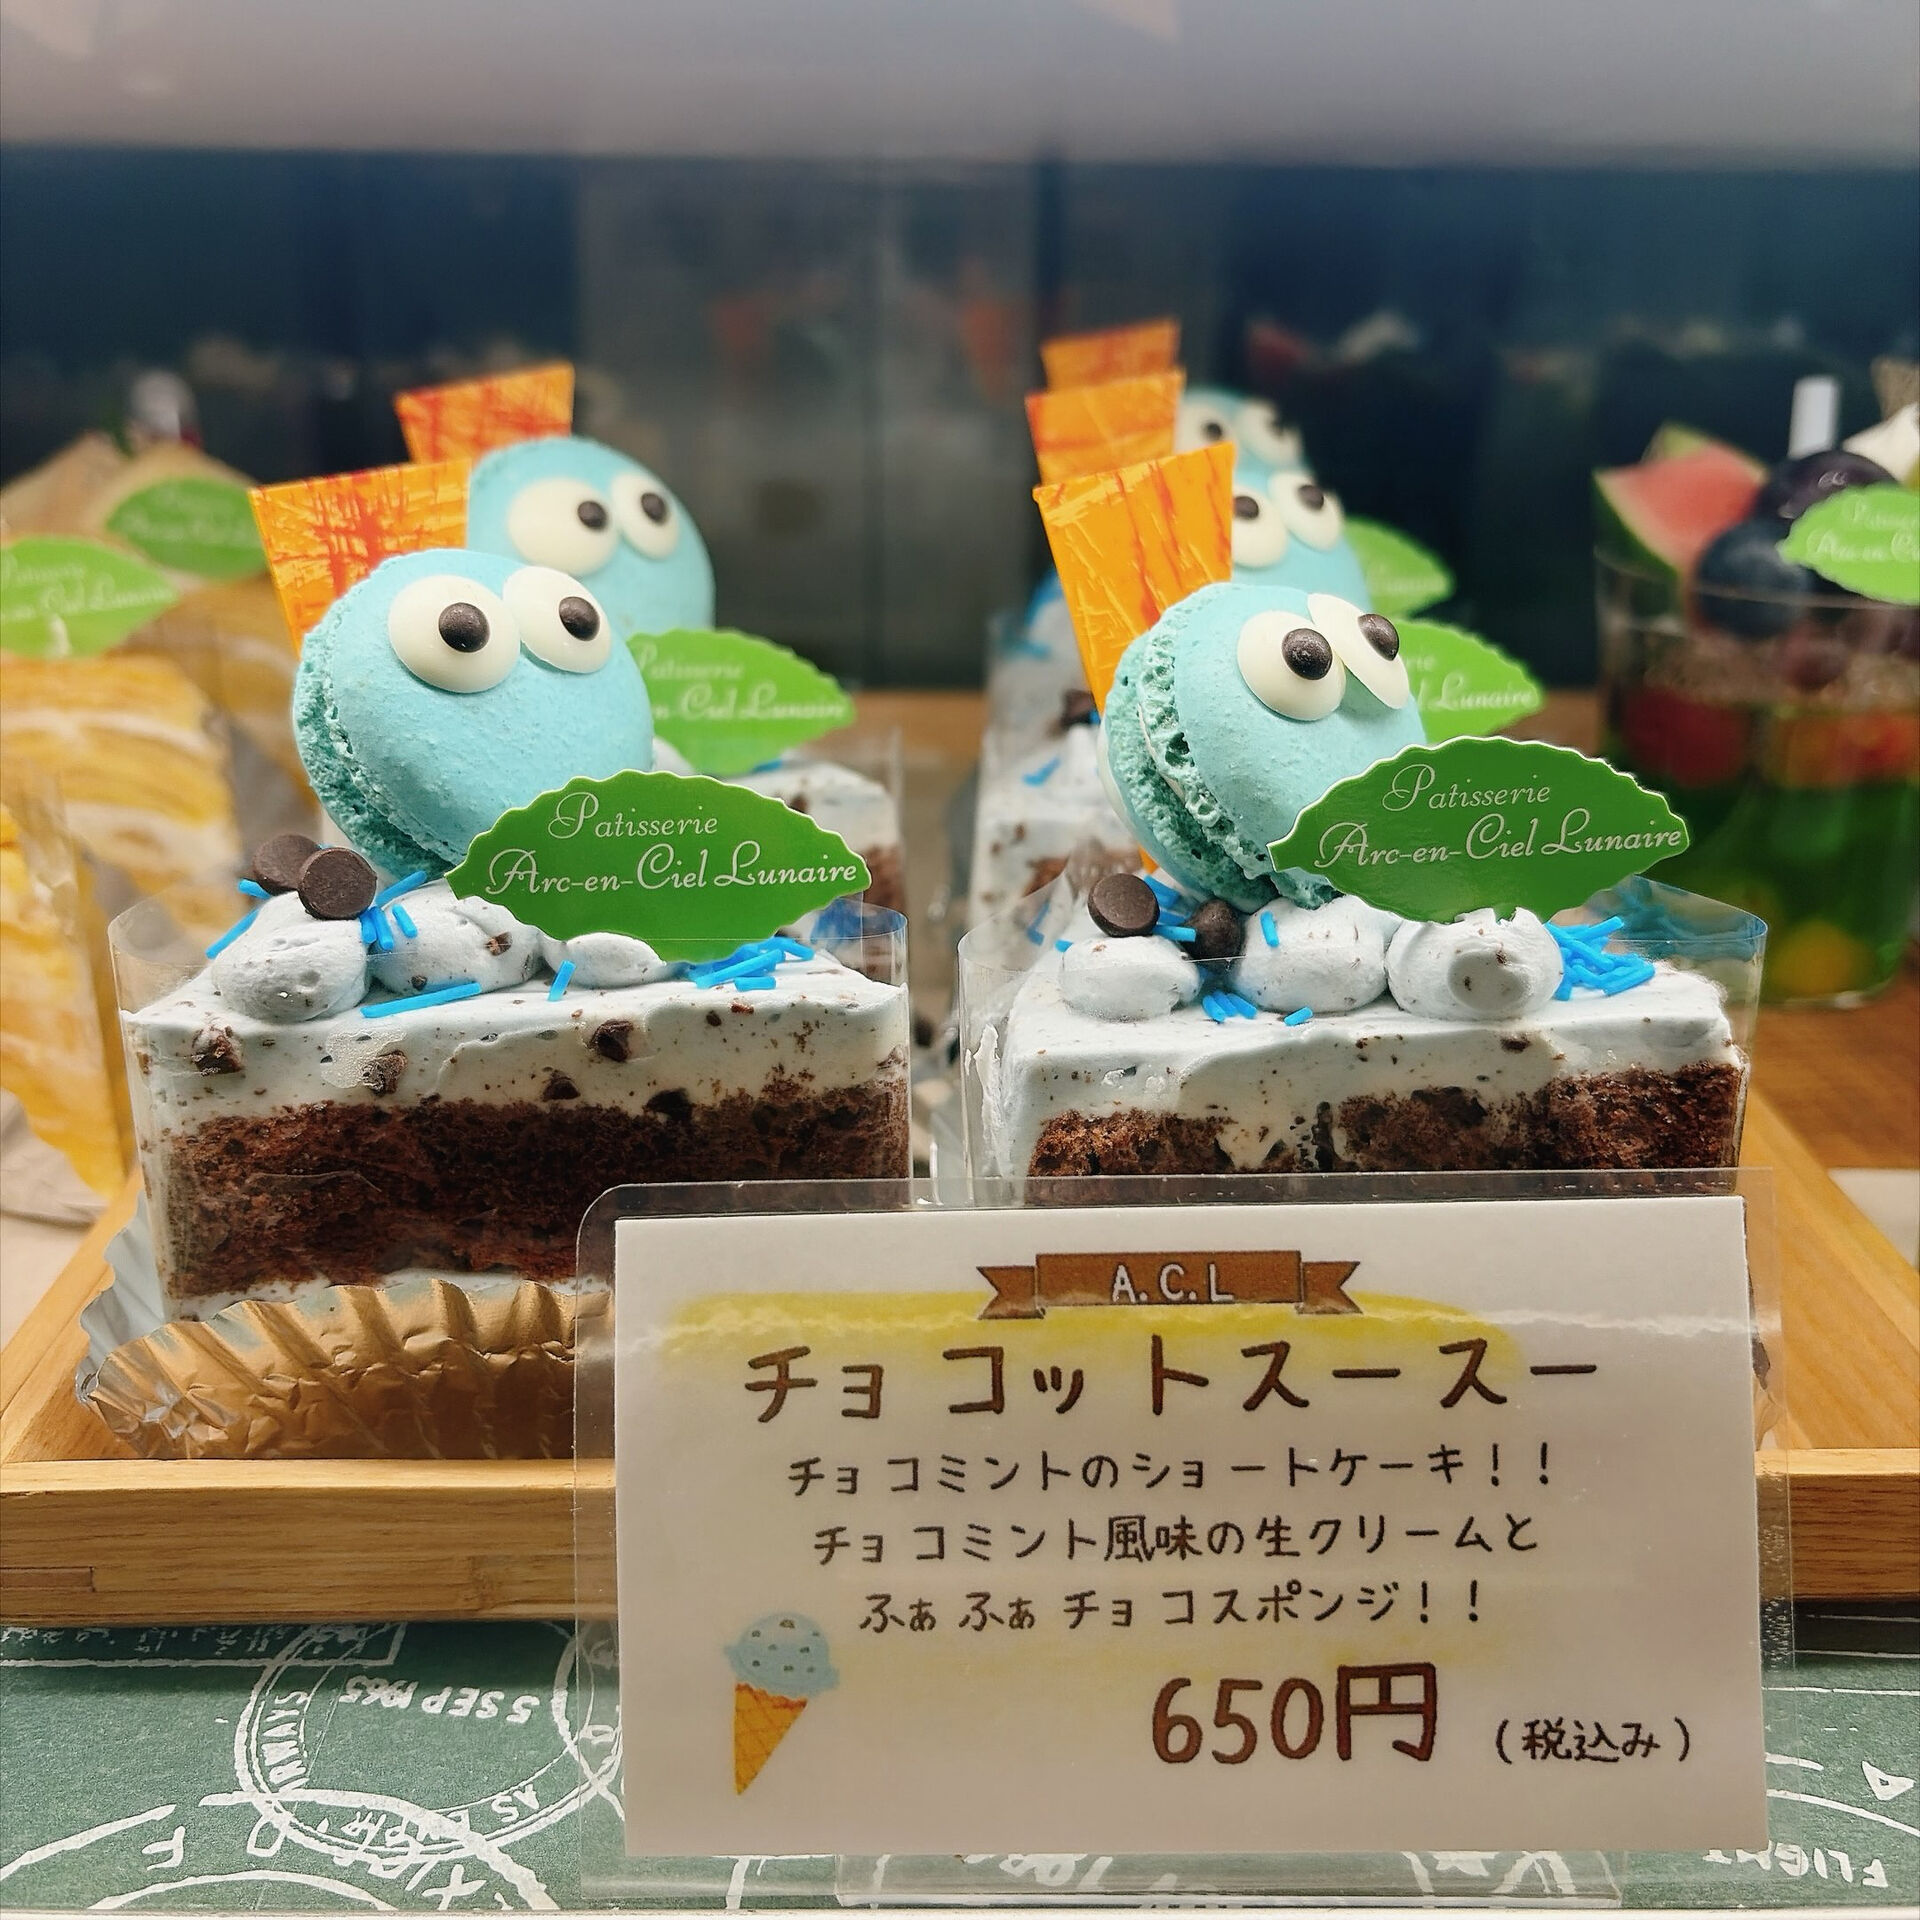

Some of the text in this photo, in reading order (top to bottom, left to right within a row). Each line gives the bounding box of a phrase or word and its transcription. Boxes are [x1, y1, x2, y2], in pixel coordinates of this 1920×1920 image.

[1382, 763, 1551, 812] Patisserie
[548, 792, 718, 839] Patisserie
[1314, 808, 1681, 868] Arc-en-Ciel Lunaire
[485, 840, 858, 895] Arc-en-Ciel Lunaire
[1111, 1262, 1235, 1303] A.C.L
[743, 1332, 1599, 1424] チョコットスースー
[788, 1441, 1550, 1497] チョコミントのショートケーキ！！
[814, 1512, 1539, 1566] チョコミント風味の生クリームと
[421, 1686, 505, 1720] SEP
[1151, 1661, 1691, 1766] 650円 (税込み)
